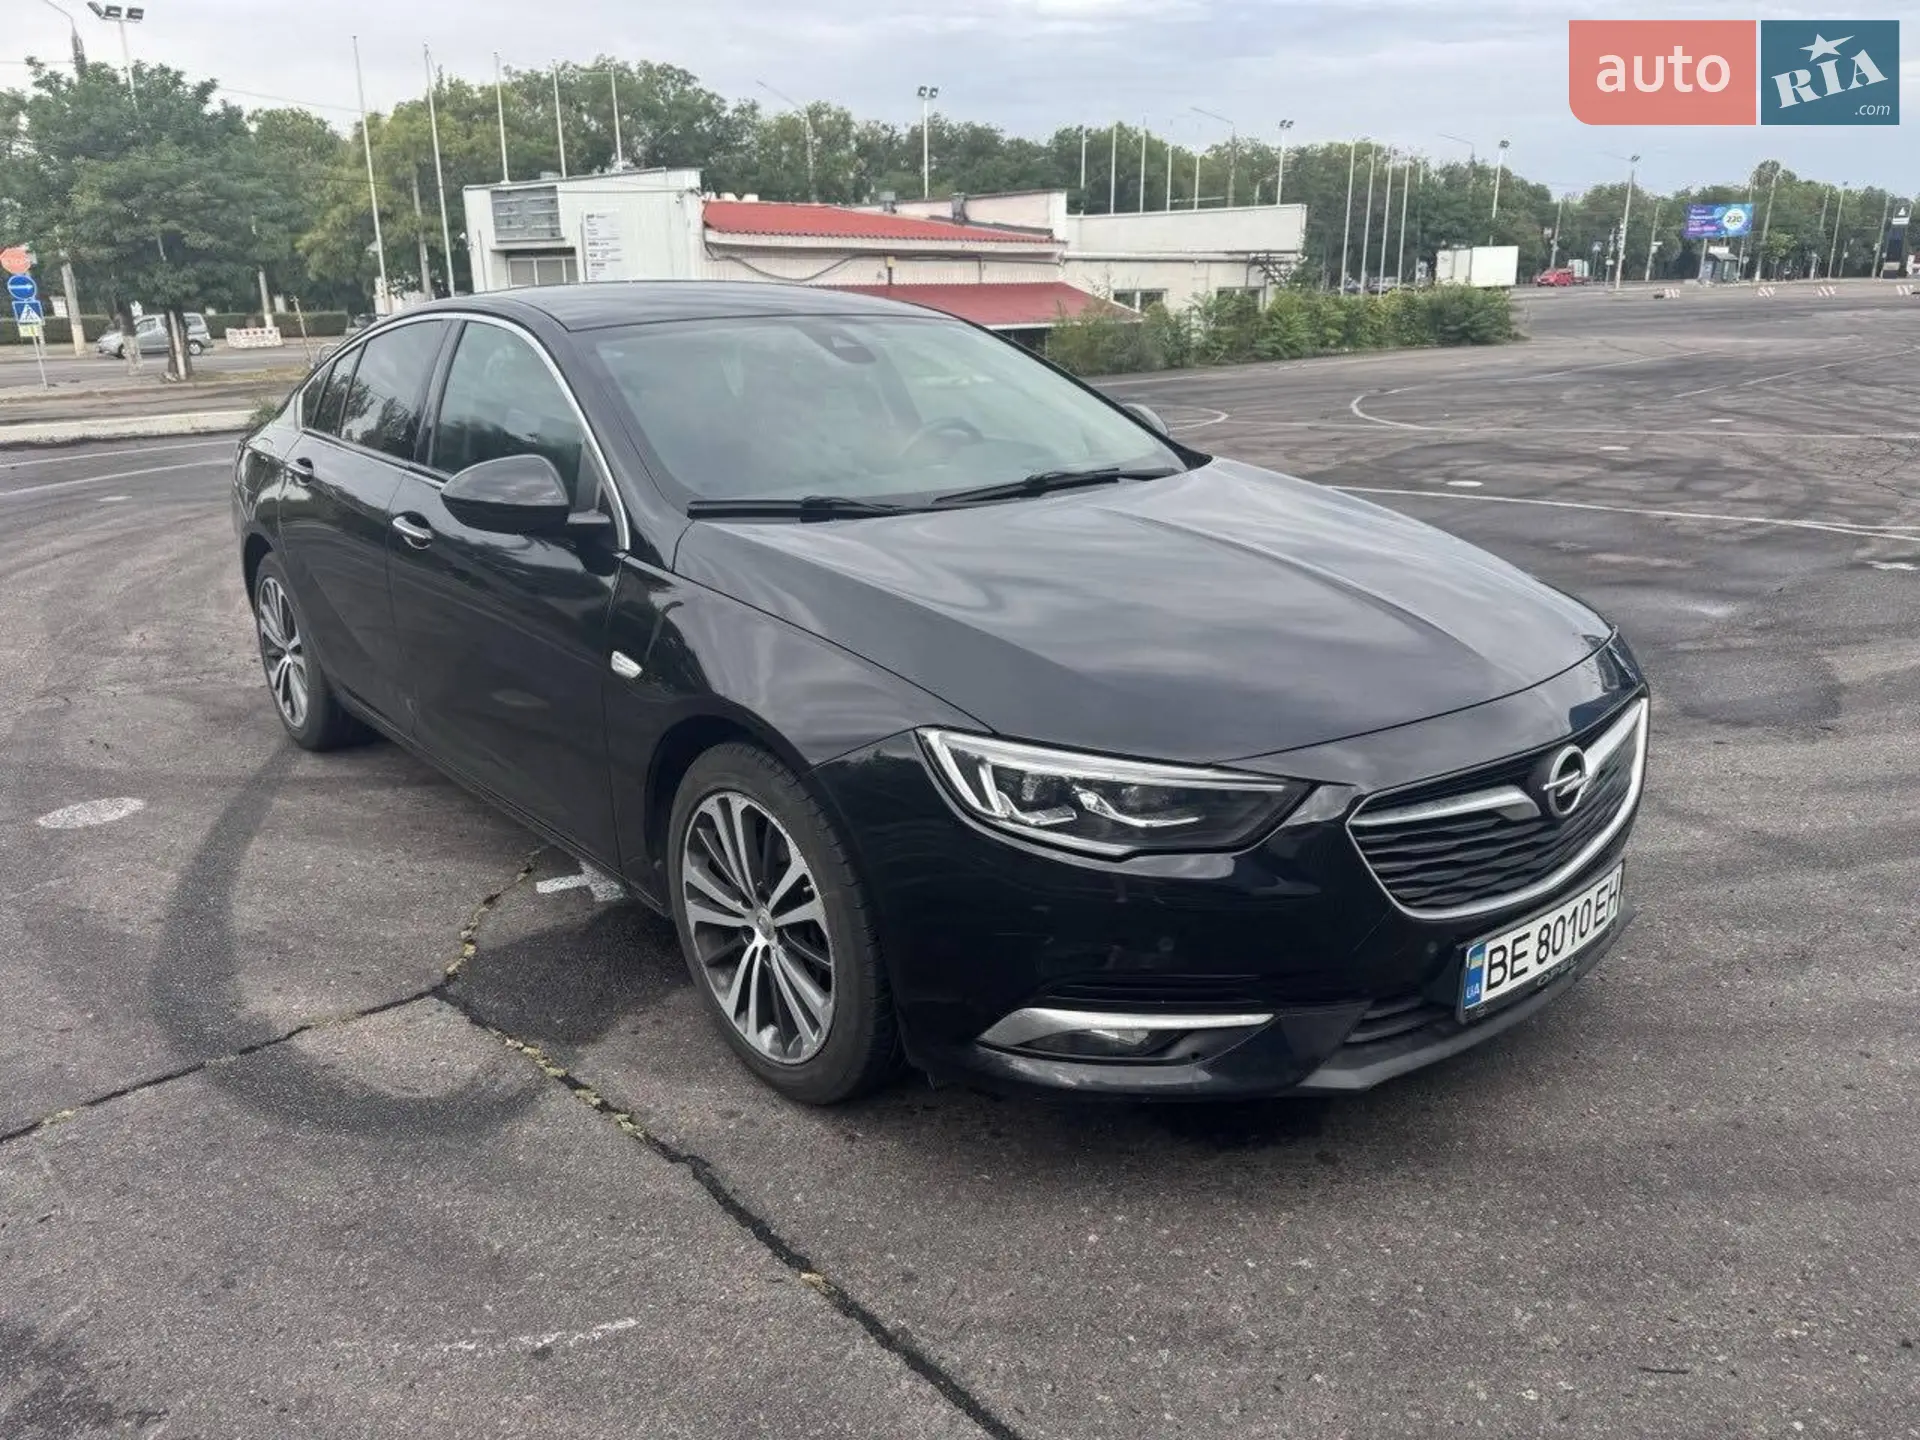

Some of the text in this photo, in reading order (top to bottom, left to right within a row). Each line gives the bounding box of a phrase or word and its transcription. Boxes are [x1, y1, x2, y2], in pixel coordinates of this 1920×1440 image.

[1486, 932, 1531, 992] BE
[1536, 898, 1592, 965] 8010
[1466, 985, 1480, 999] UA
